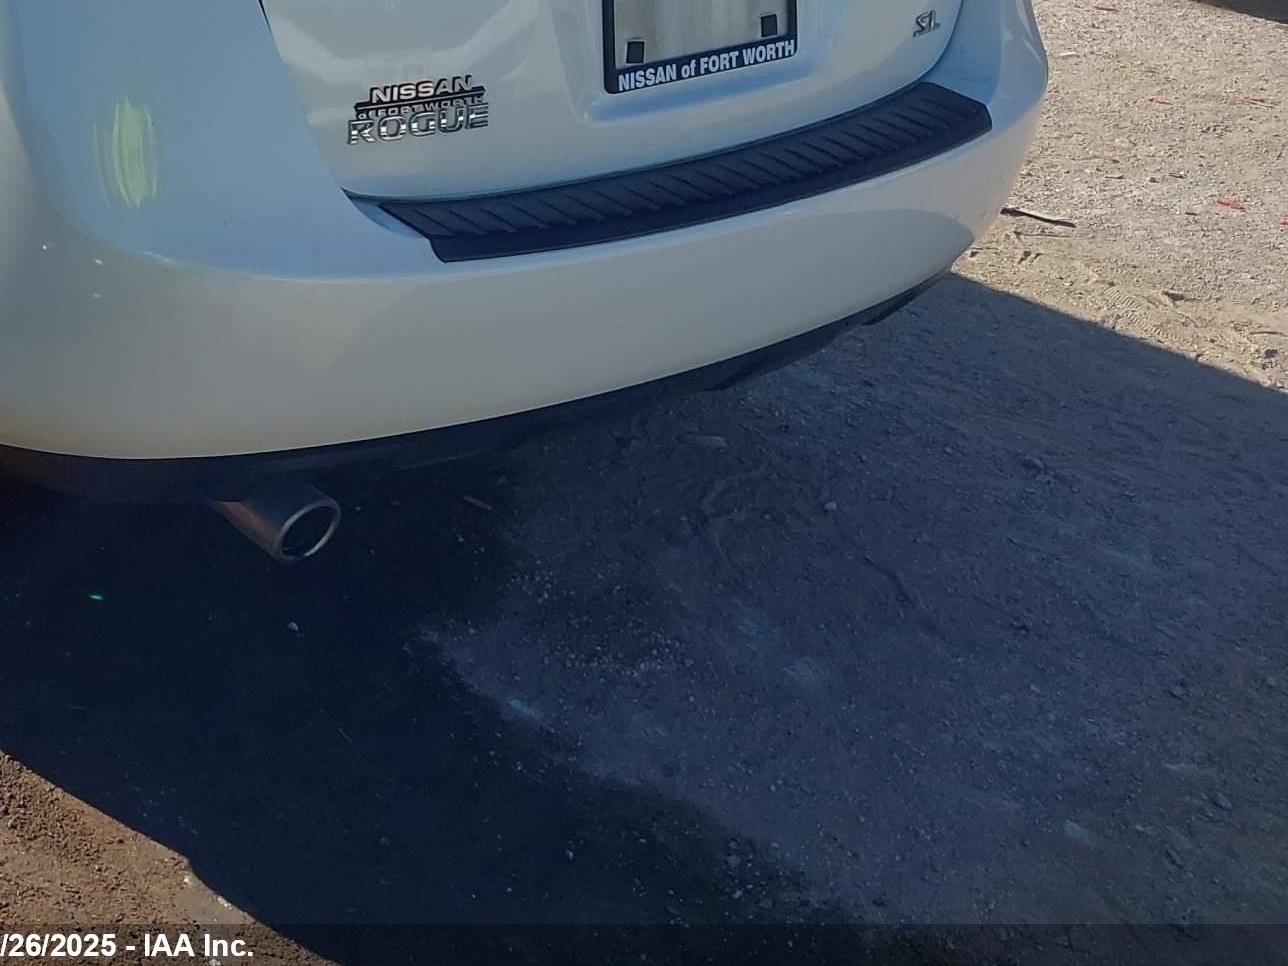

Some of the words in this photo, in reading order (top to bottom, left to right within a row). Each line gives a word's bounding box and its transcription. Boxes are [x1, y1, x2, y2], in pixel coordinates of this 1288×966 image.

[618, 63, 677, 92] NISSAN
[681, 60, 697, 79] of
[700, 51, 740, 75] FORT
[742, 39, 795, 65] WORTH
[368, 73, 474, 105] NISSAN
[346, 101, 489, 146] ROGUE
